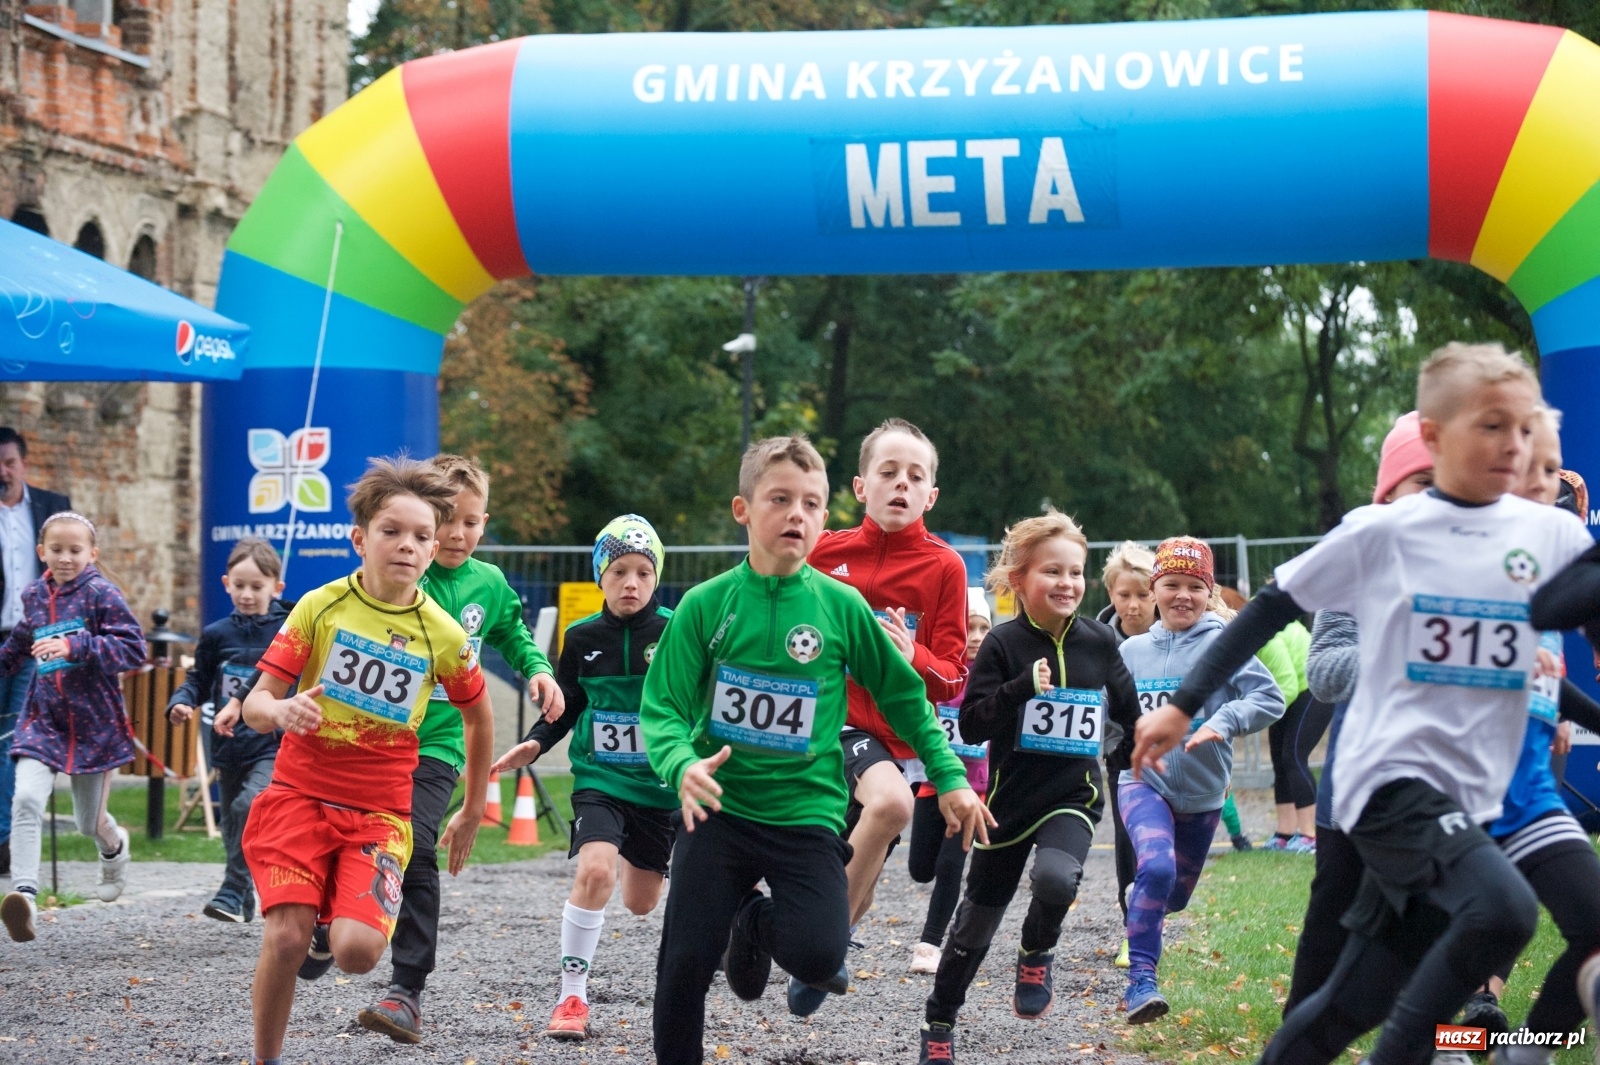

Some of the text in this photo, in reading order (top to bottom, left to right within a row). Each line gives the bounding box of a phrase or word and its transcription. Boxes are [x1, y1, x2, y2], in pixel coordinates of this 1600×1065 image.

[632, 43, 1305, 103] GMINA KRZYŻANOWICE
[845, 137, 1084, 229] META
[340, 632, 424, 670] TIME-SPORT.PL
[1421, 616, 1519, 669] 313
[332, 649, 412, 704] 303
[722, 670, 814, 695] TIME-SPORT.PL
[721, 687, 804, 735] 304
[1040, 690, 1100, 703] ME-SPORT.PL
[595, 713, 640, 723] TIME-SPO
[1032, 701, 1096, 740] 315
[602, 724, 637, 752] 31
